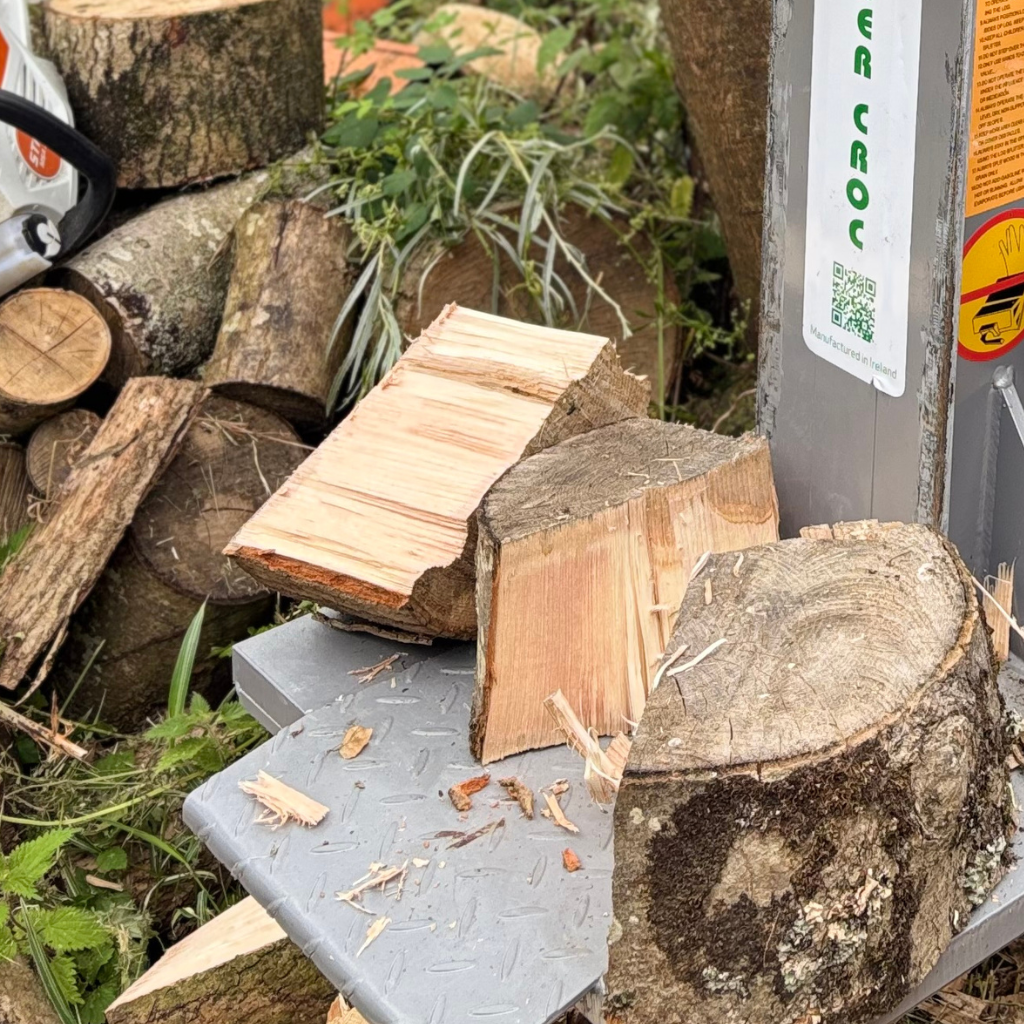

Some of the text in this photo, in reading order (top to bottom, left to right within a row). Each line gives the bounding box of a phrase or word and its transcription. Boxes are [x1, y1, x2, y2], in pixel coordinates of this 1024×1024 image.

[846, 104, 869, 250] CROC
[810, 324, 898, 380] Manufactured in Ireland
